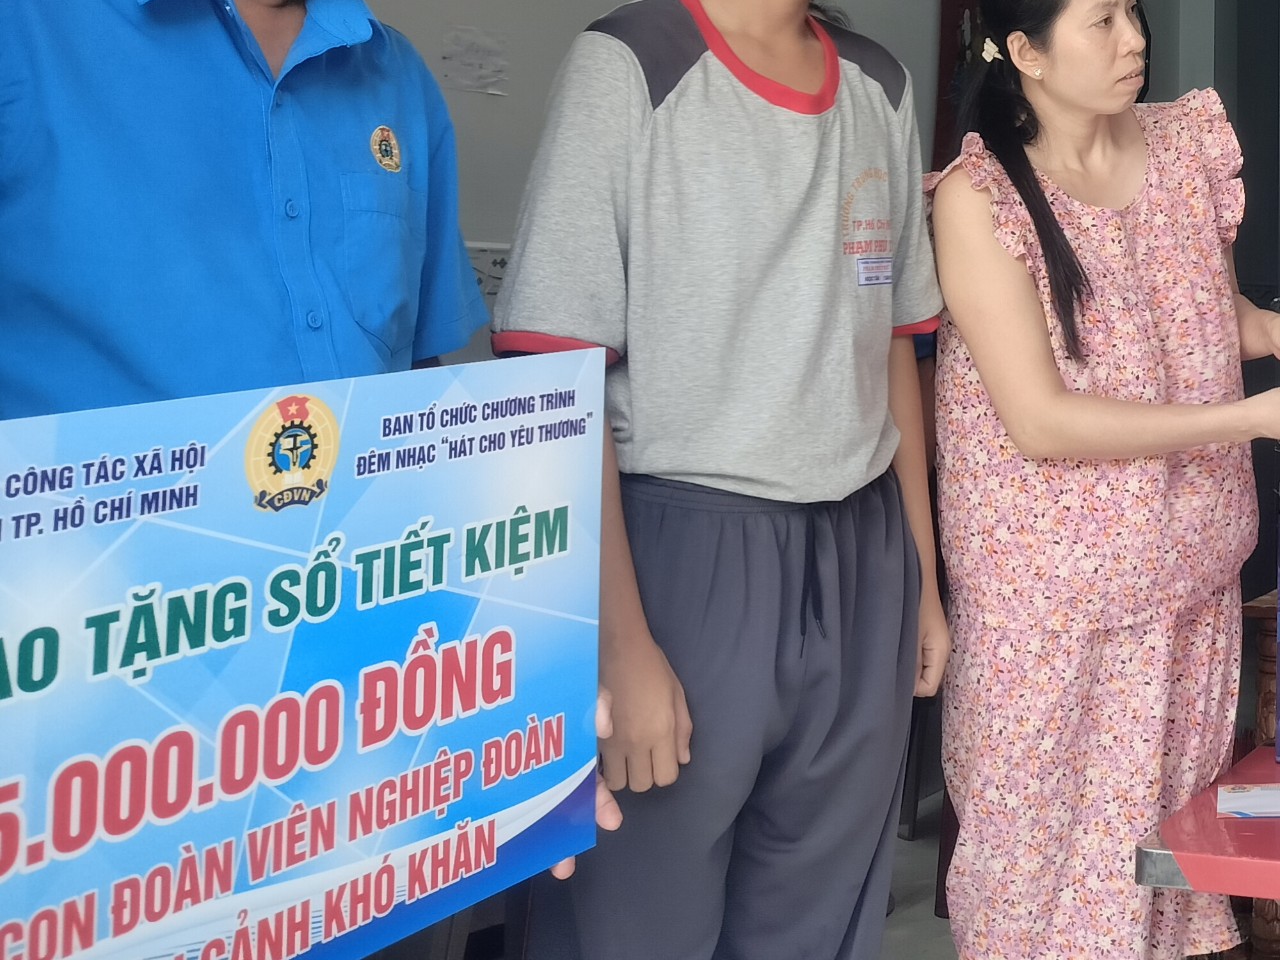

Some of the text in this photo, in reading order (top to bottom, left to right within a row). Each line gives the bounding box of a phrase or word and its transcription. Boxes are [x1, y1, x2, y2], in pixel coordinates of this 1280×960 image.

[356, 450, 391, 476] ĐÊM
[395, 444, 436, 469] NHẠC
[479, 431, 505, 454] CHO
[510, 425, 534, 448] YÊU
[382, 388, 576, 438] BAN TỔ CHỨC CHƯƠNG TRÌNH
[5, 442, 207, 498] CÔNG TÁC XÃ HỘI
[12, 513, 43, 539] TP.
[53, 496, 85, 532] HỒ
[93, 491, 132, 524] CHÍ
[140, 484, 199, 516] MINH
[85, 581, 248, 679] TẶNG
[267, 537, 342, 628] SỔ
[355, 519, 451, 605] TIẾT
[464, 506, 570, 576] KIỆM
[360, 626, 514, 747] ĐỒNG
[111, 840, 234, 938] ĐOÀN
[247, 801, 336, 882] VIÊN
[348, 755, 473, 835] NGHIỆP
[481, 715, 565, 789] ĐOÀN
[324, 847, 396, 940] KHÓ
[407, 819, 497, 902] KHĂN
